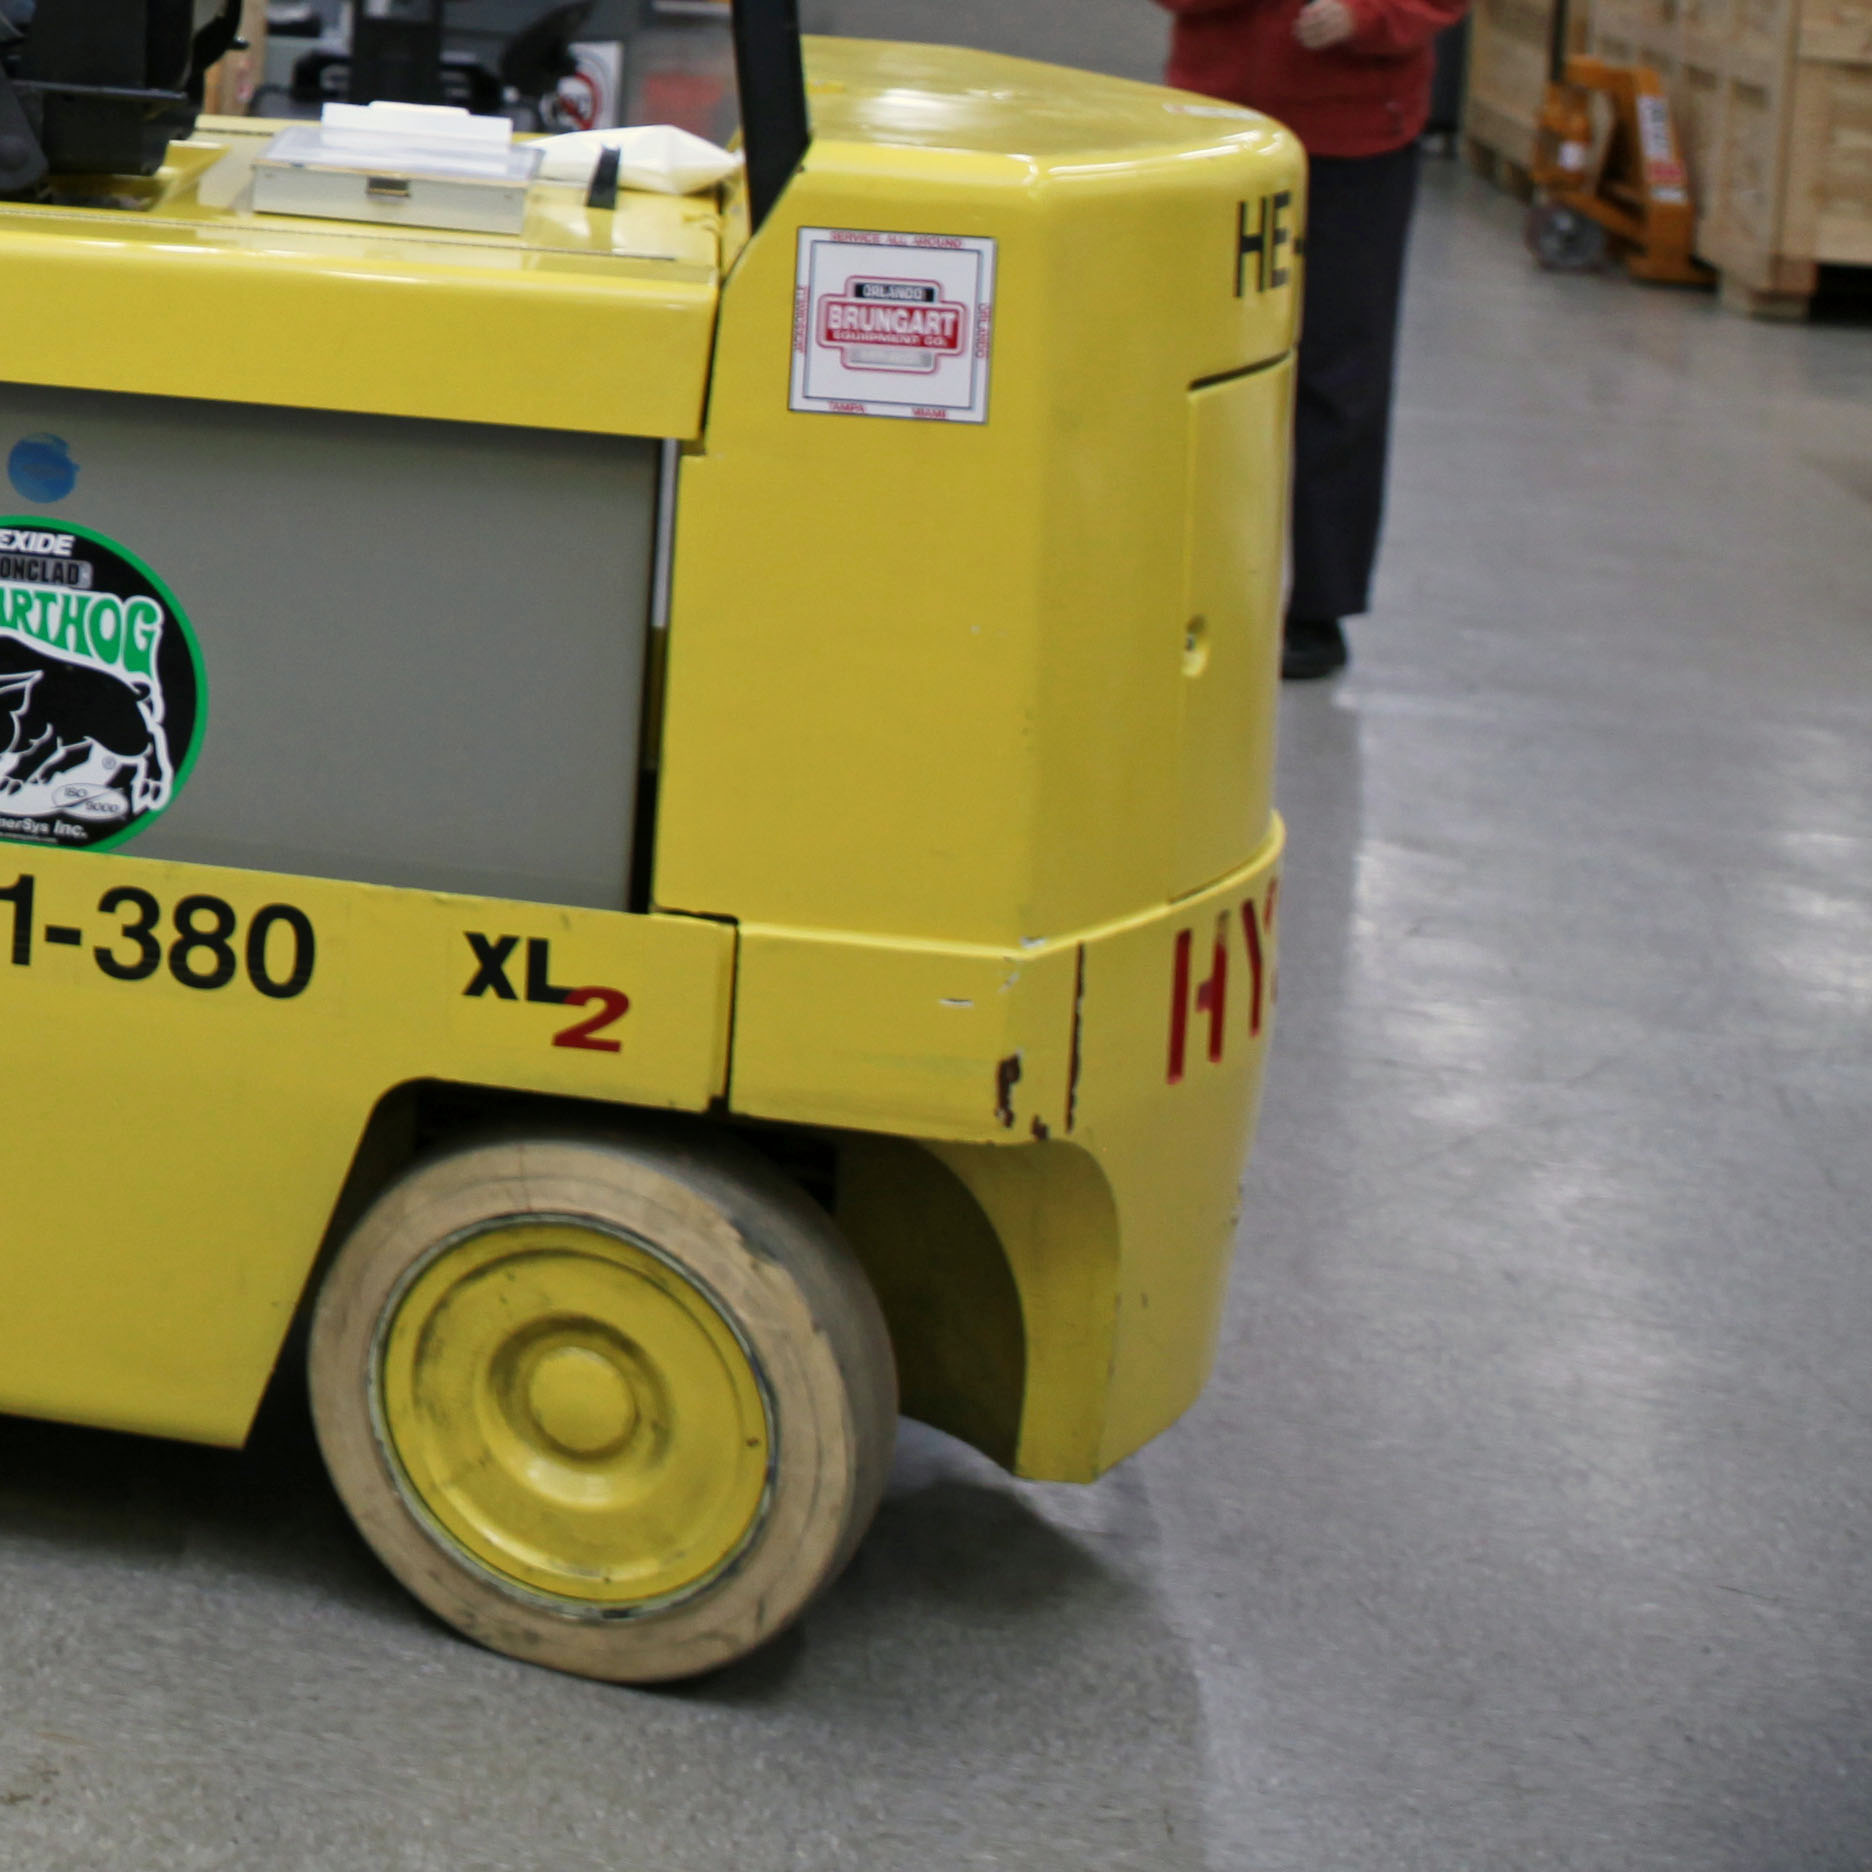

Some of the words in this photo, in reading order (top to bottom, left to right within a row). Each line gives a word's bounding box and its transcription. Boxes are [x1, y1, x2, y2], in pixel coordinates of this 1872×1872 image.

[862, 284, 923, 300] ORLANDO
[828, 304, 956, 337] BRUNGART
[832, 329, 921, 345] EQUIPMENT
[53, 819, 88, 839] Inc.
